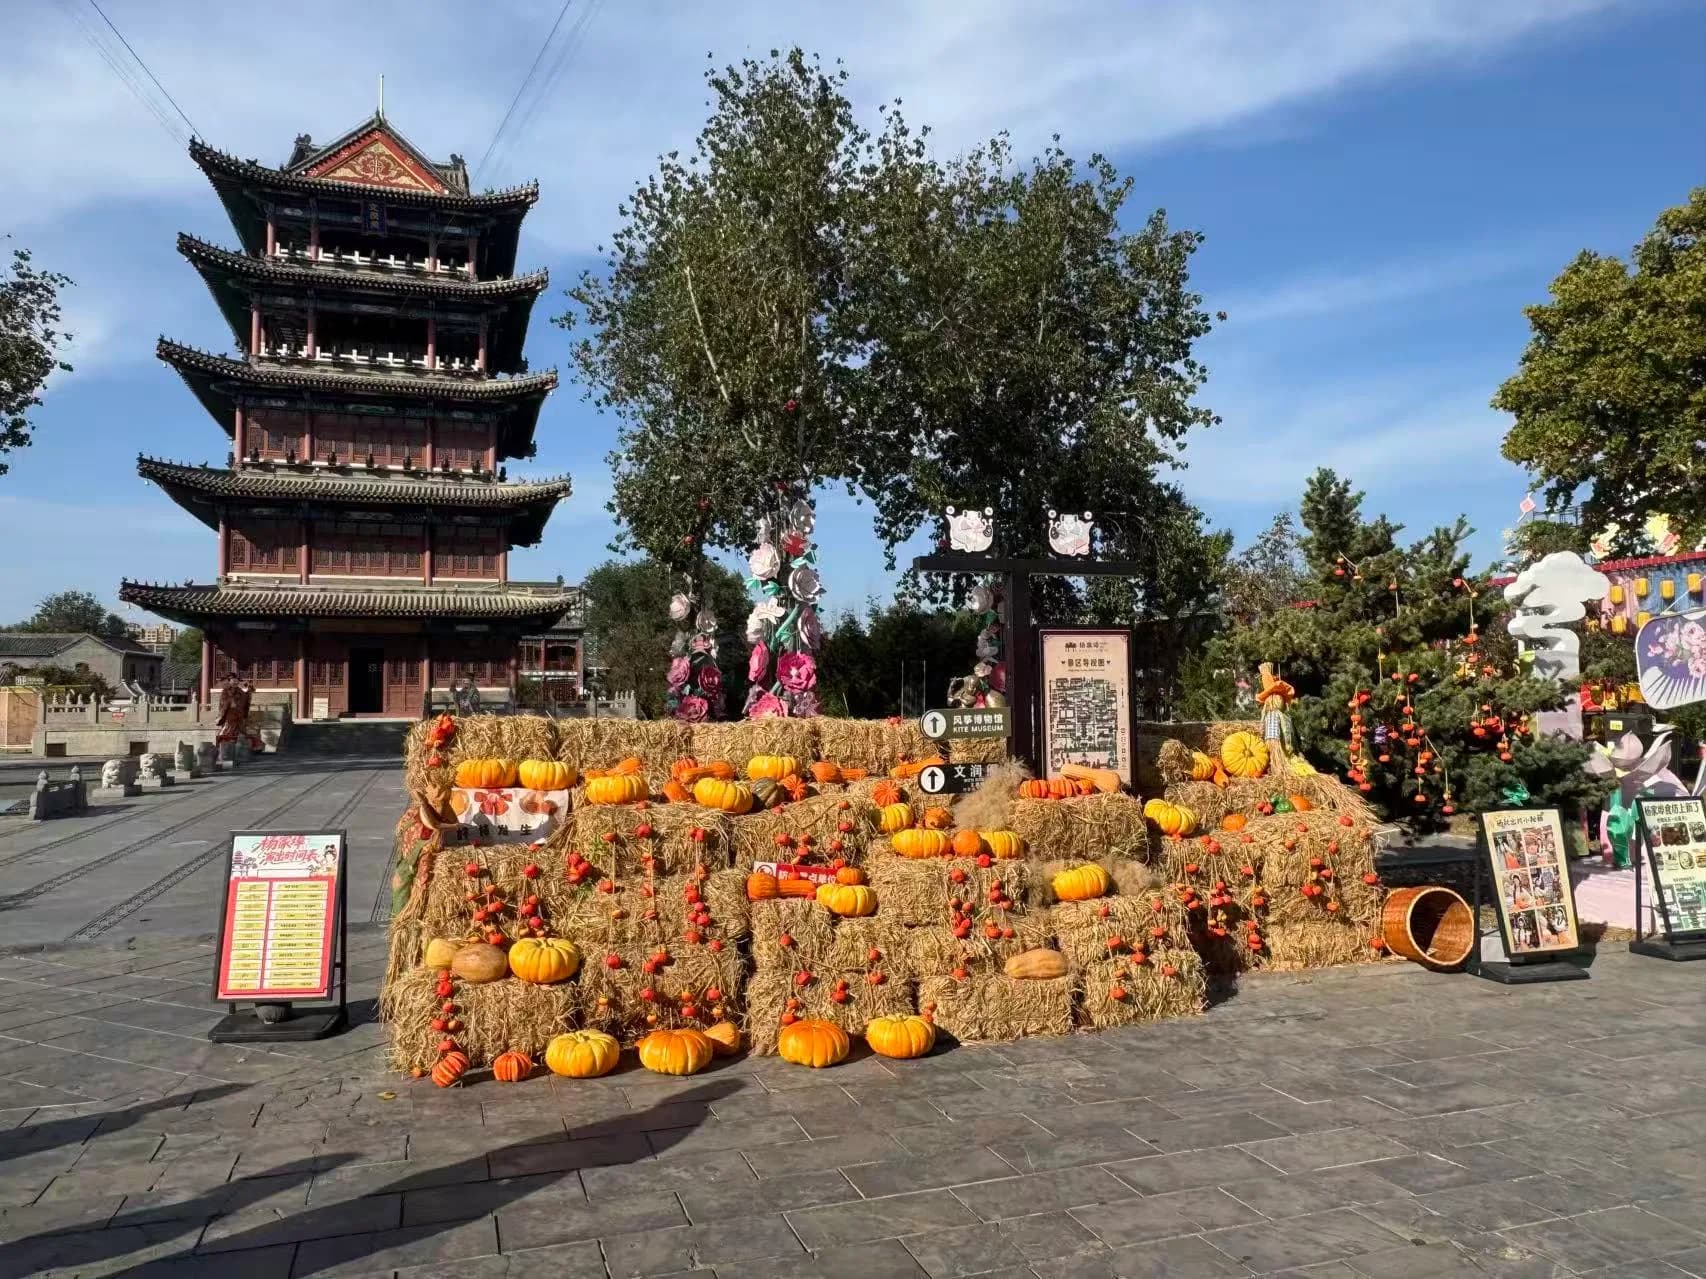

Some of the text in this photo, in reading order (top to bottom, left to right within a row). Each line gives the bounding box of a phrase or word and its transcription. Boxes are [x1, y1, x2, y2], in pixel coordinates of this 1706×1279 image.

[953, 713, 1003, 725] 风筝博物馆
[971, 724, 1004, 732] MUSEUM
